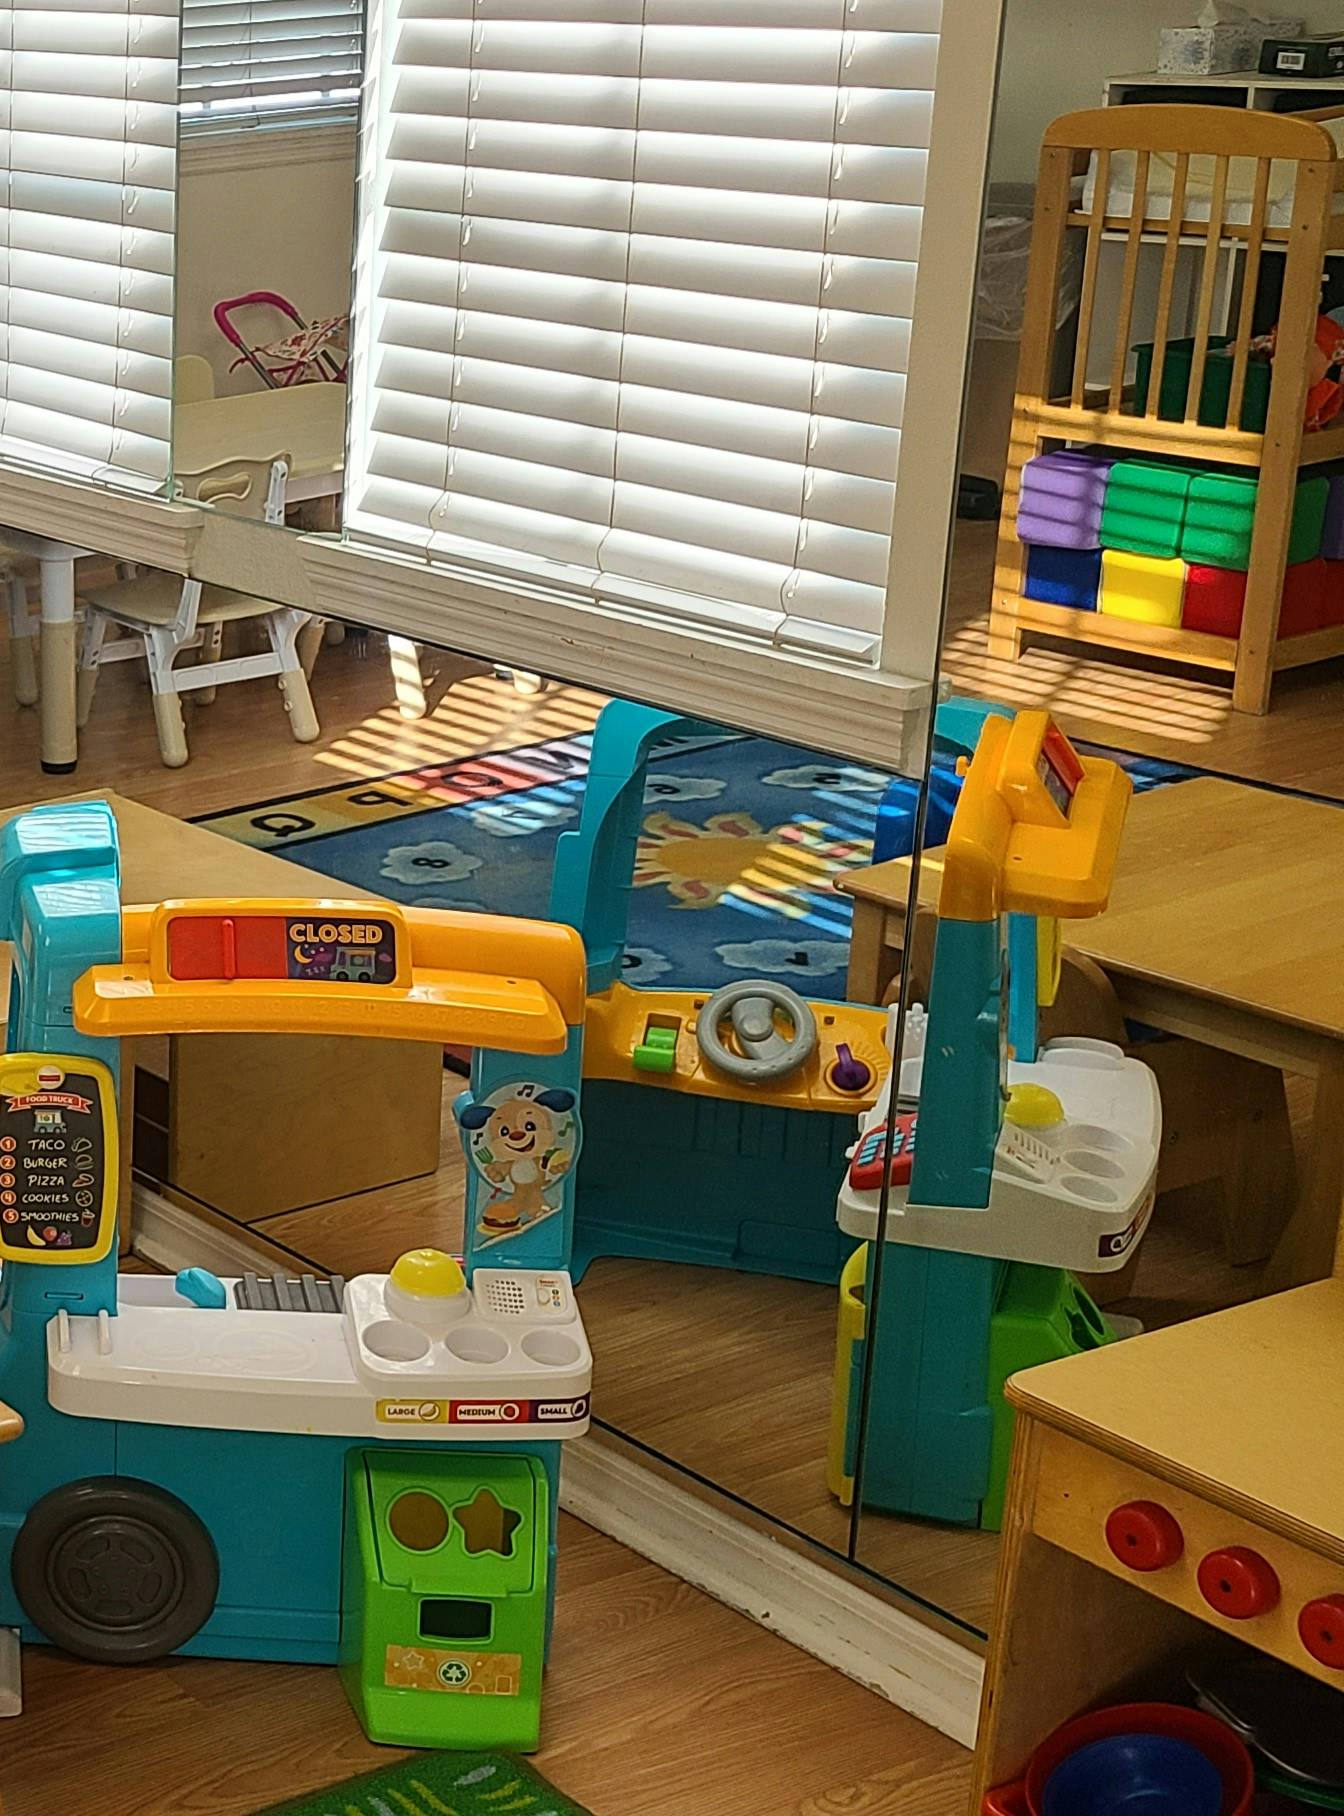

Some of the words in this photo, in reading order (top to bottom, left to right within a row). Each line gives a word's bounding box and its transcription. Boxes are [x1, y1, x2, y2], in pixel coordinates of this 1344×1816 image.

[289, 923, 383, 944] CLOSED
[26, 1095, 48, 1103] FOOD
[49, 1095, 74, 1104] TRUCK
[28, 1139, 65, 1150] TACO
[23, 1157, 67, 1169] BURGER
[27, 1175, 65, 1187] PIZZA
[22, 1193, 69, 1203] COOKIES
[20, 1212, 79, 1222] SMOOTHIES
[388, 1408, 415, 1416] LARGE
[459, 1407, 496, 1416] MEDIUM
[540, 1407, 568, 1416] SMALL
